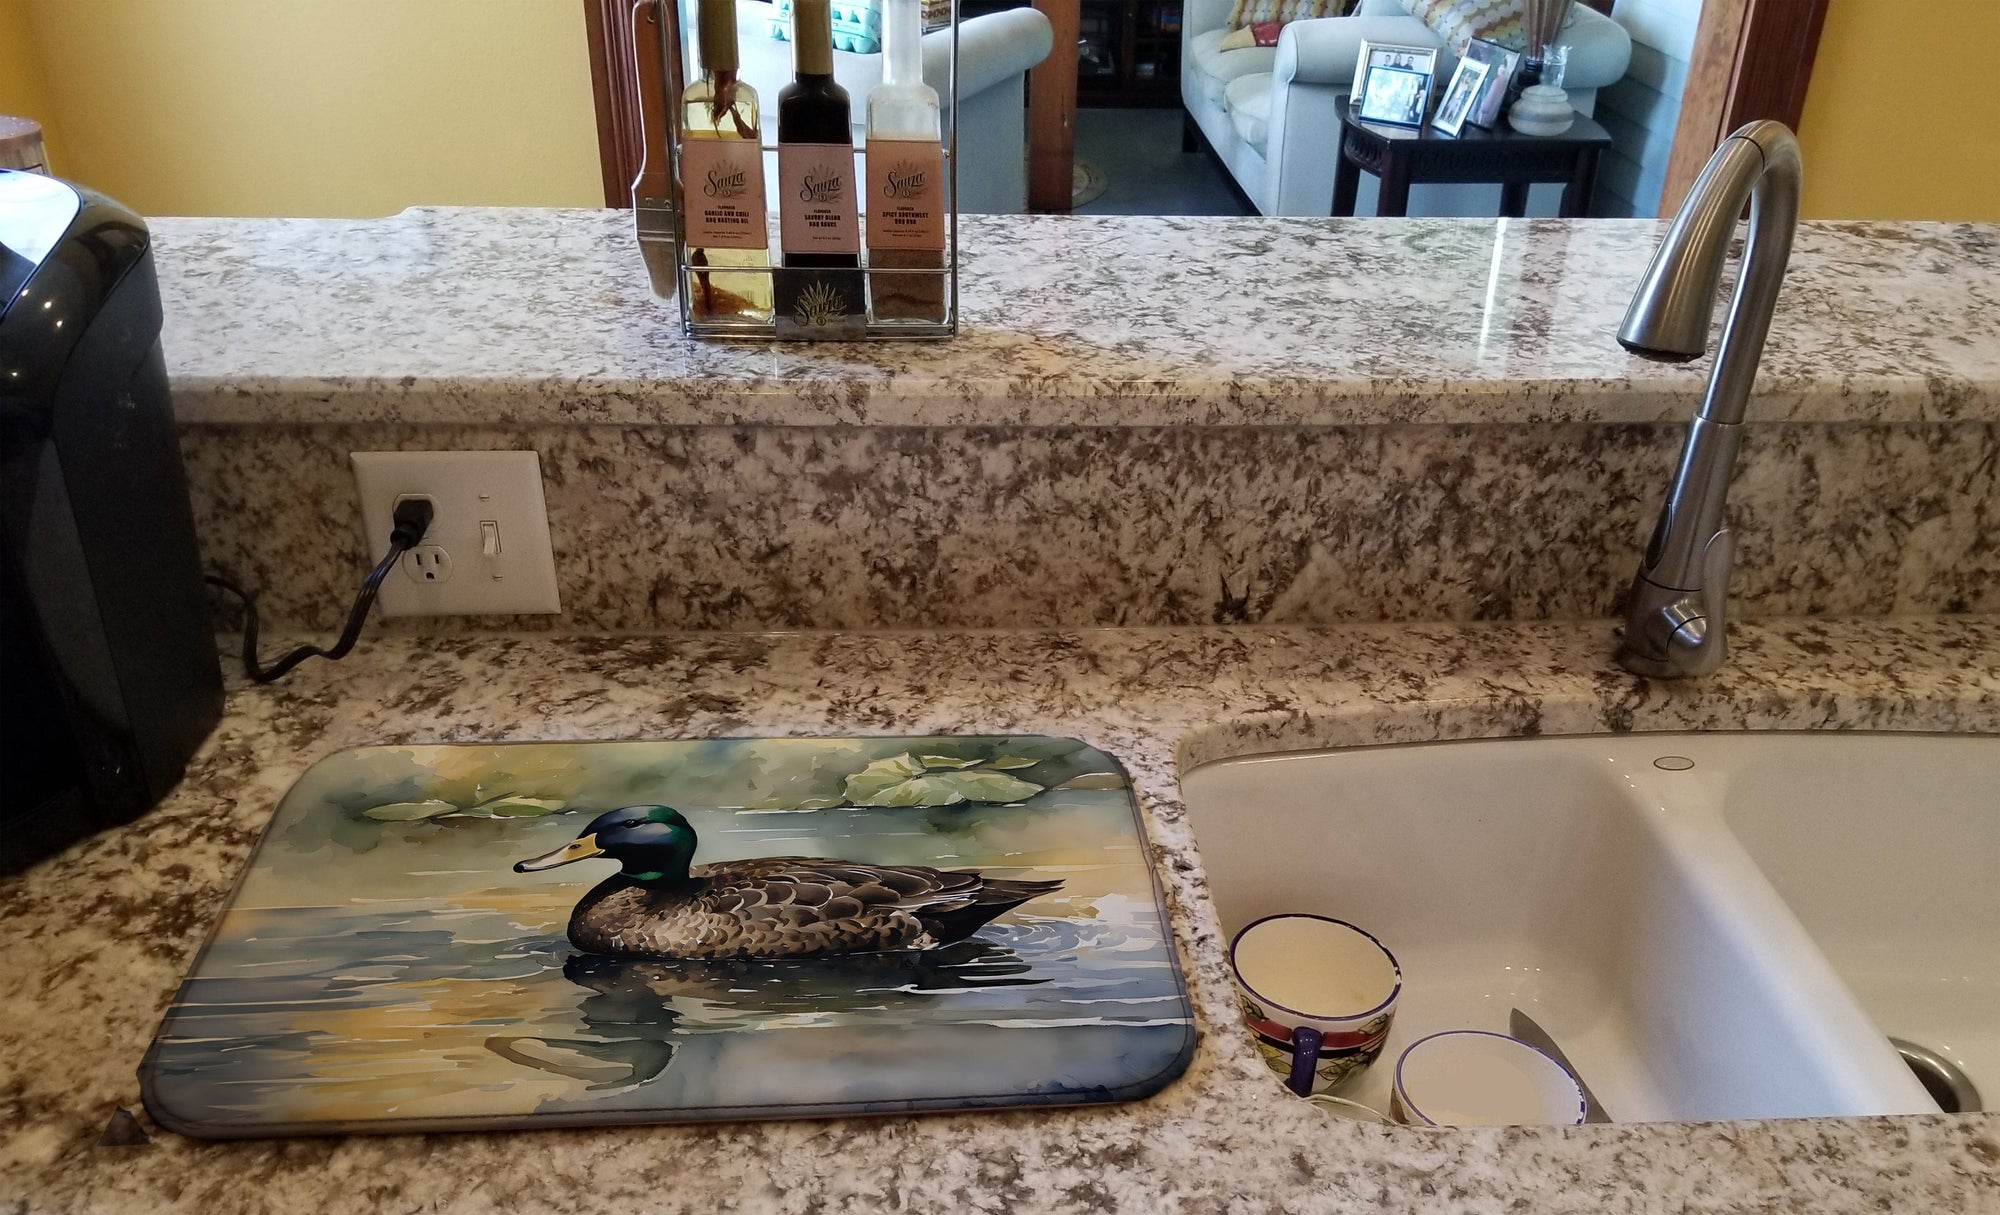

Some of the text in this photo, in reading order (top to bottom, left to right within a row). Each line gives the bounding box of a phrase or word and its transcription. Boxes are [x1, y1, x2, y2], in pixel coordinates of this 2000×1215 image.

[703, 170, 745, 197] Sauza
[800, 175, 841, 202] Sauza
[884, 171, 925, 198] Sauza
[792, 295, 847, 326] Sauza
